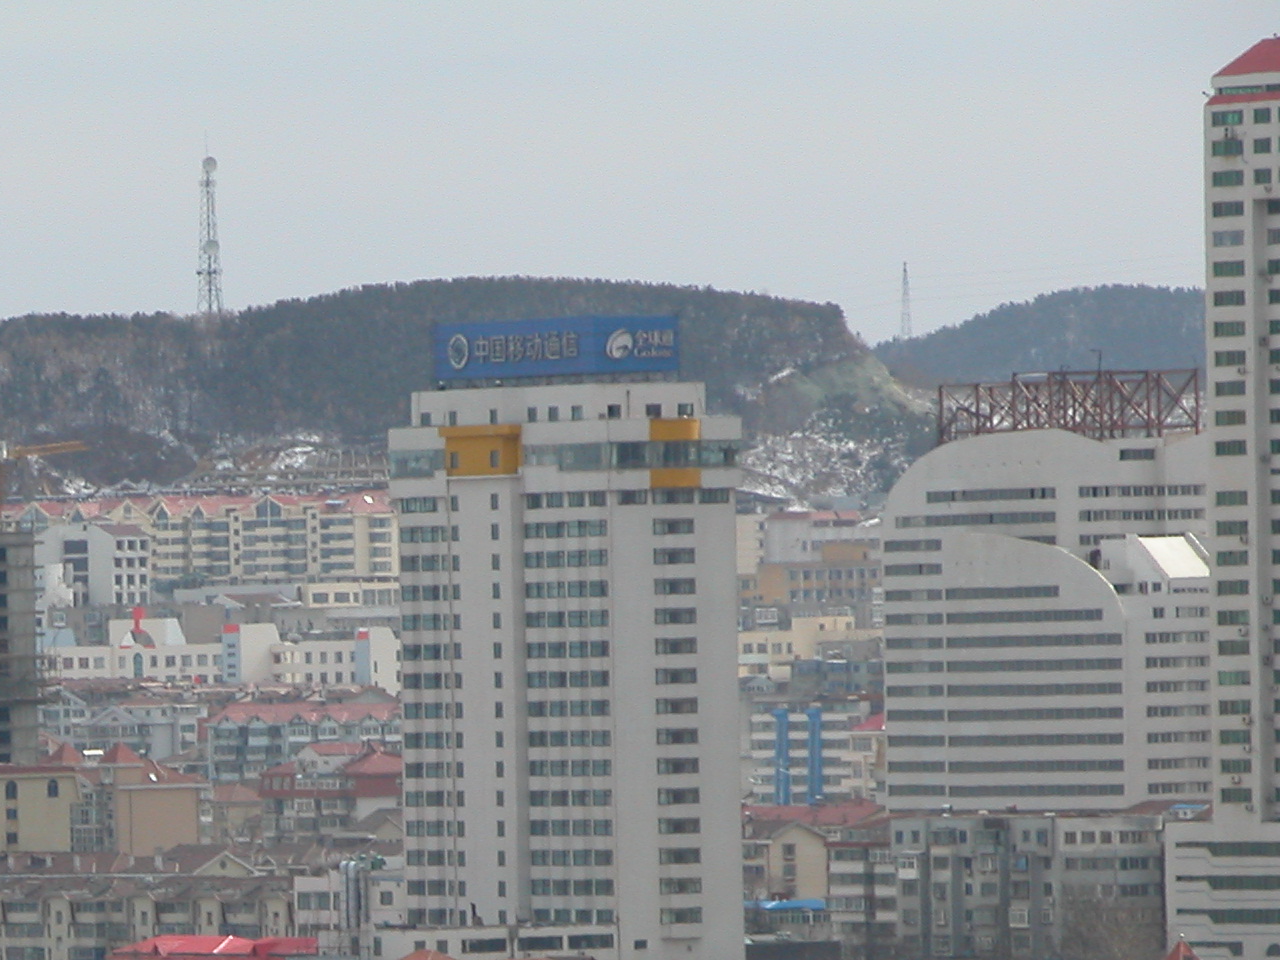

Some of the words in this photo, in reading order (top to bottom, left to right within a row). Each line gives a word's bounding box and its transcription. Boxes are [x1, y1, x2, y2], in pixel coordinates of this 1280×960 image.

[474, 331, 578, 363] 中国移动通信
